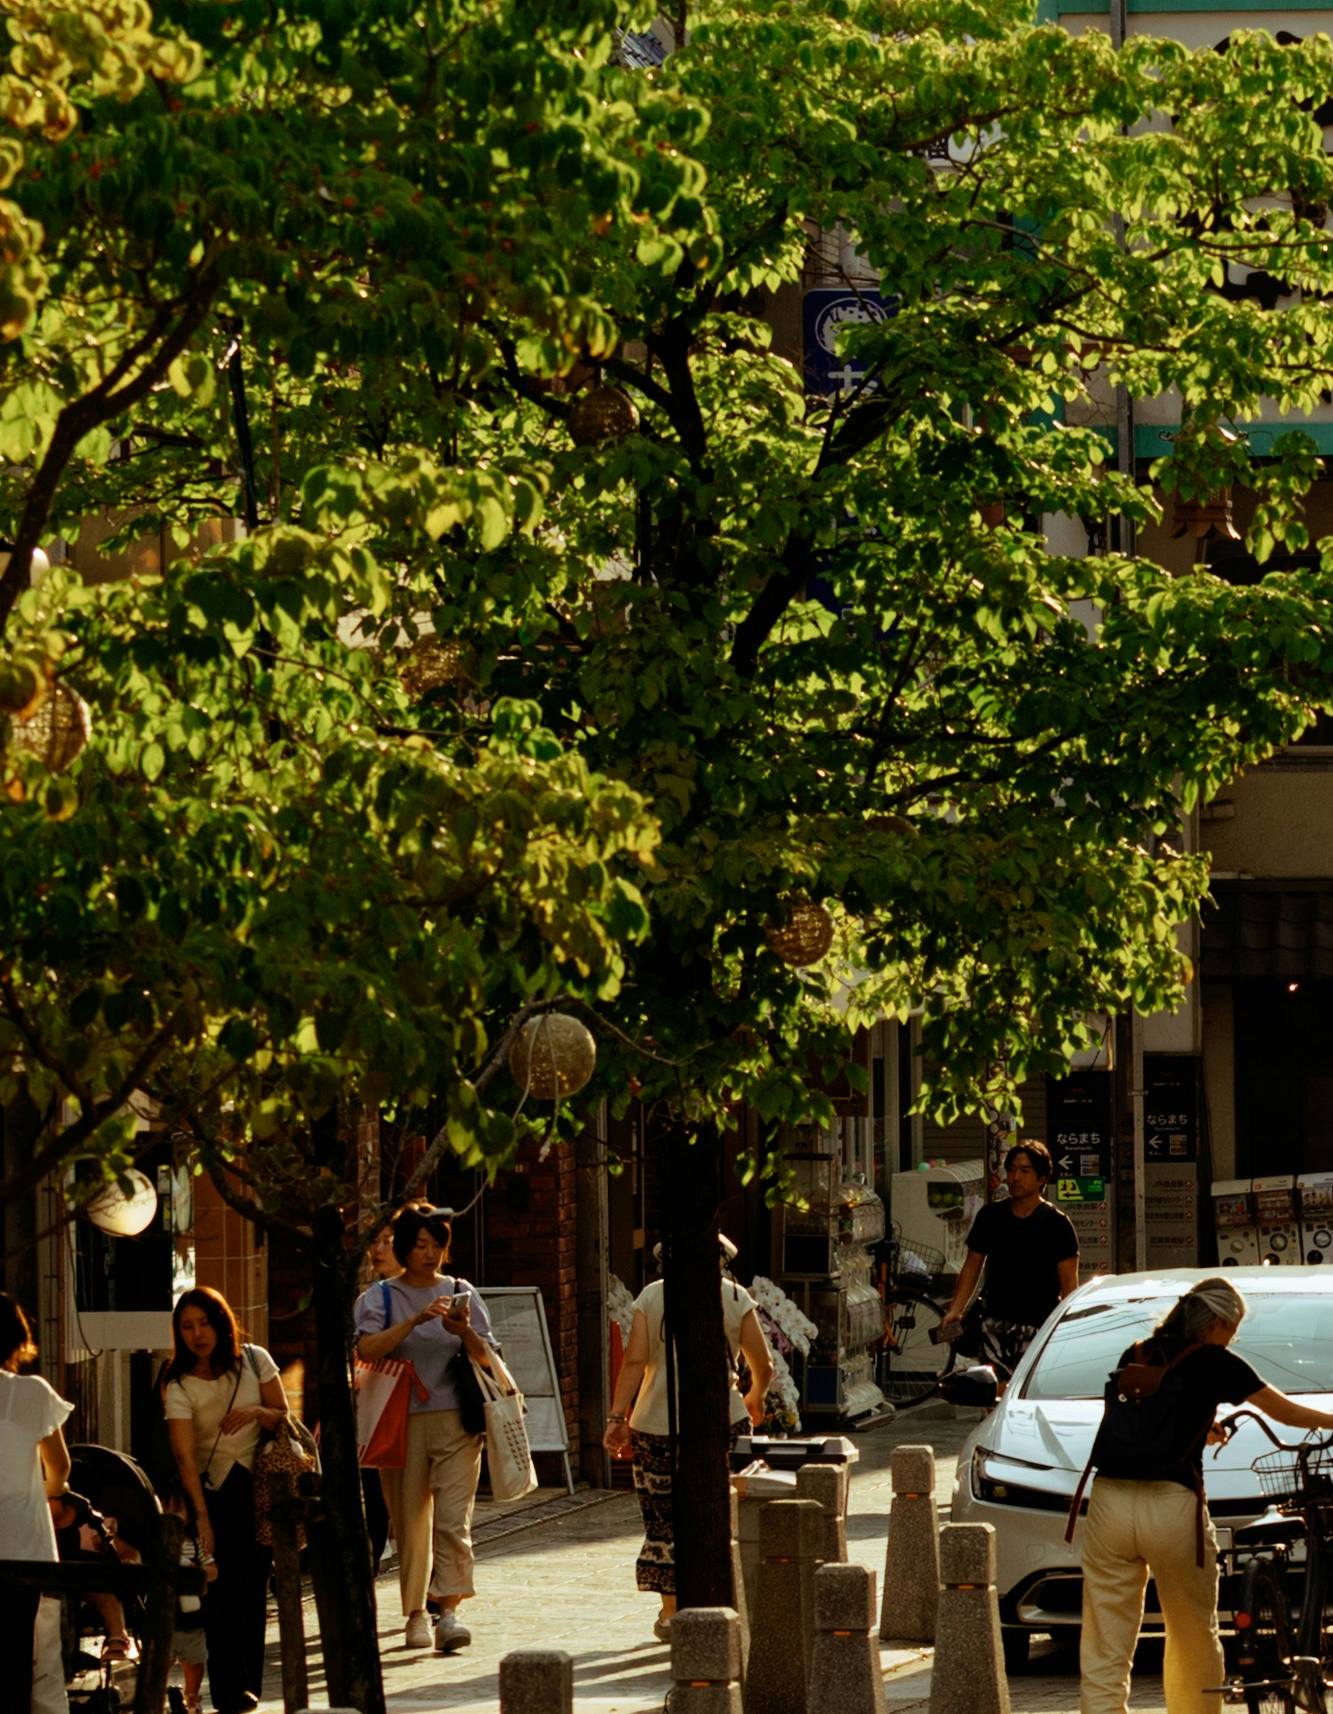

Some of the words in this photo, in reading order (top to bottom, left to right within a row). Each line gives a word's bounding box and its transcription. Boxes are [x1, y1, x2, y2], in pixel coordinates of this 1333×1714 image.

[1147, 1114, 1188, 1126] ならまち
[1057, 1132, 1100, 1145] ならまち
